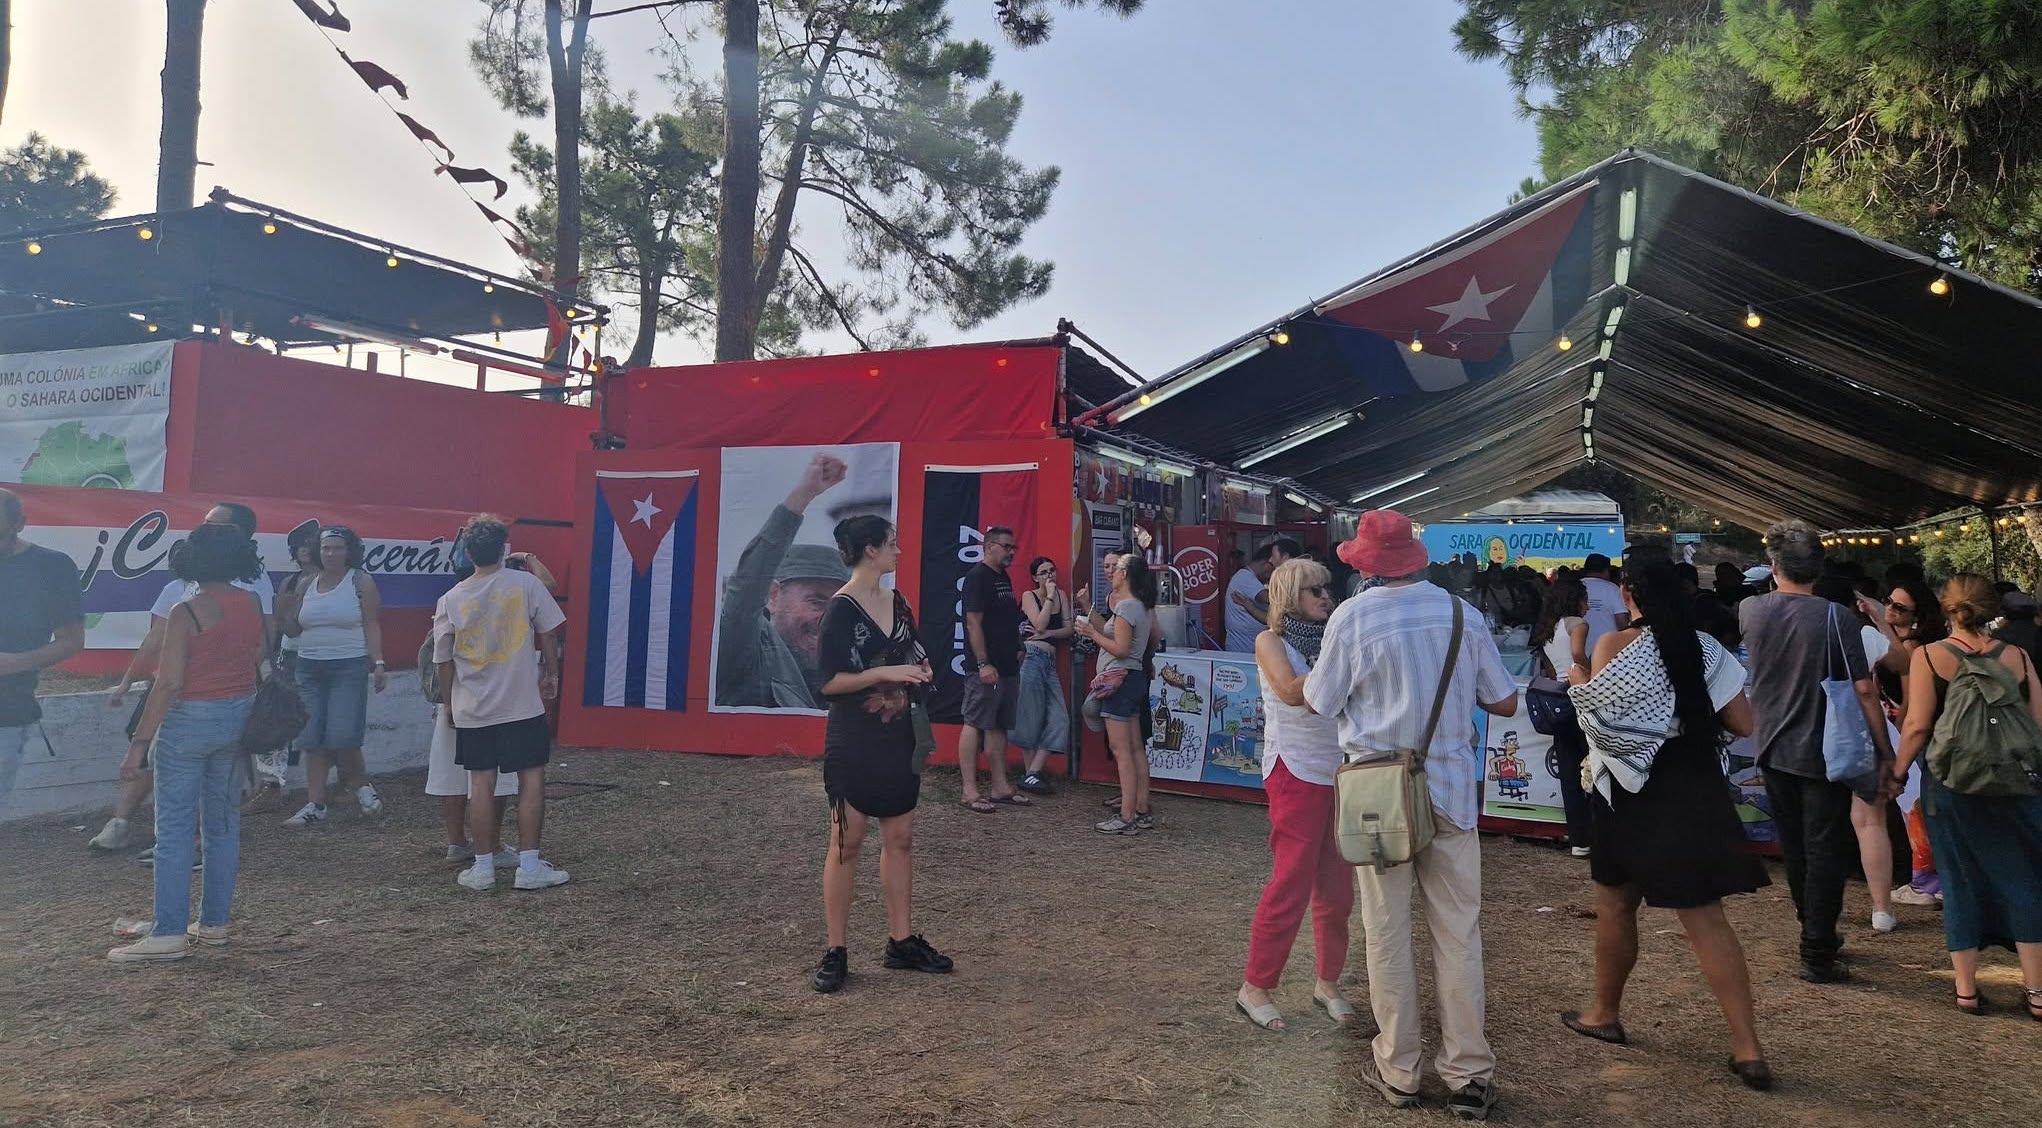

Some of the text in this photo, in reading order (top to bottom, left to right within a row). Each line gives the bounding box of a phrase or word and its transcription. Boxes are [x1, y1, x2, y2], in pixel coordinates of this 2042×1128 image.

[26, 366, 85, 384] COLÓNIA
[7, 382, 166, 408] O SAHARA OCIDENTAL!
[1449, 531, 1595, 550] SARA OCIDENTAL
[1180, 558, 1215, 577] UPER
